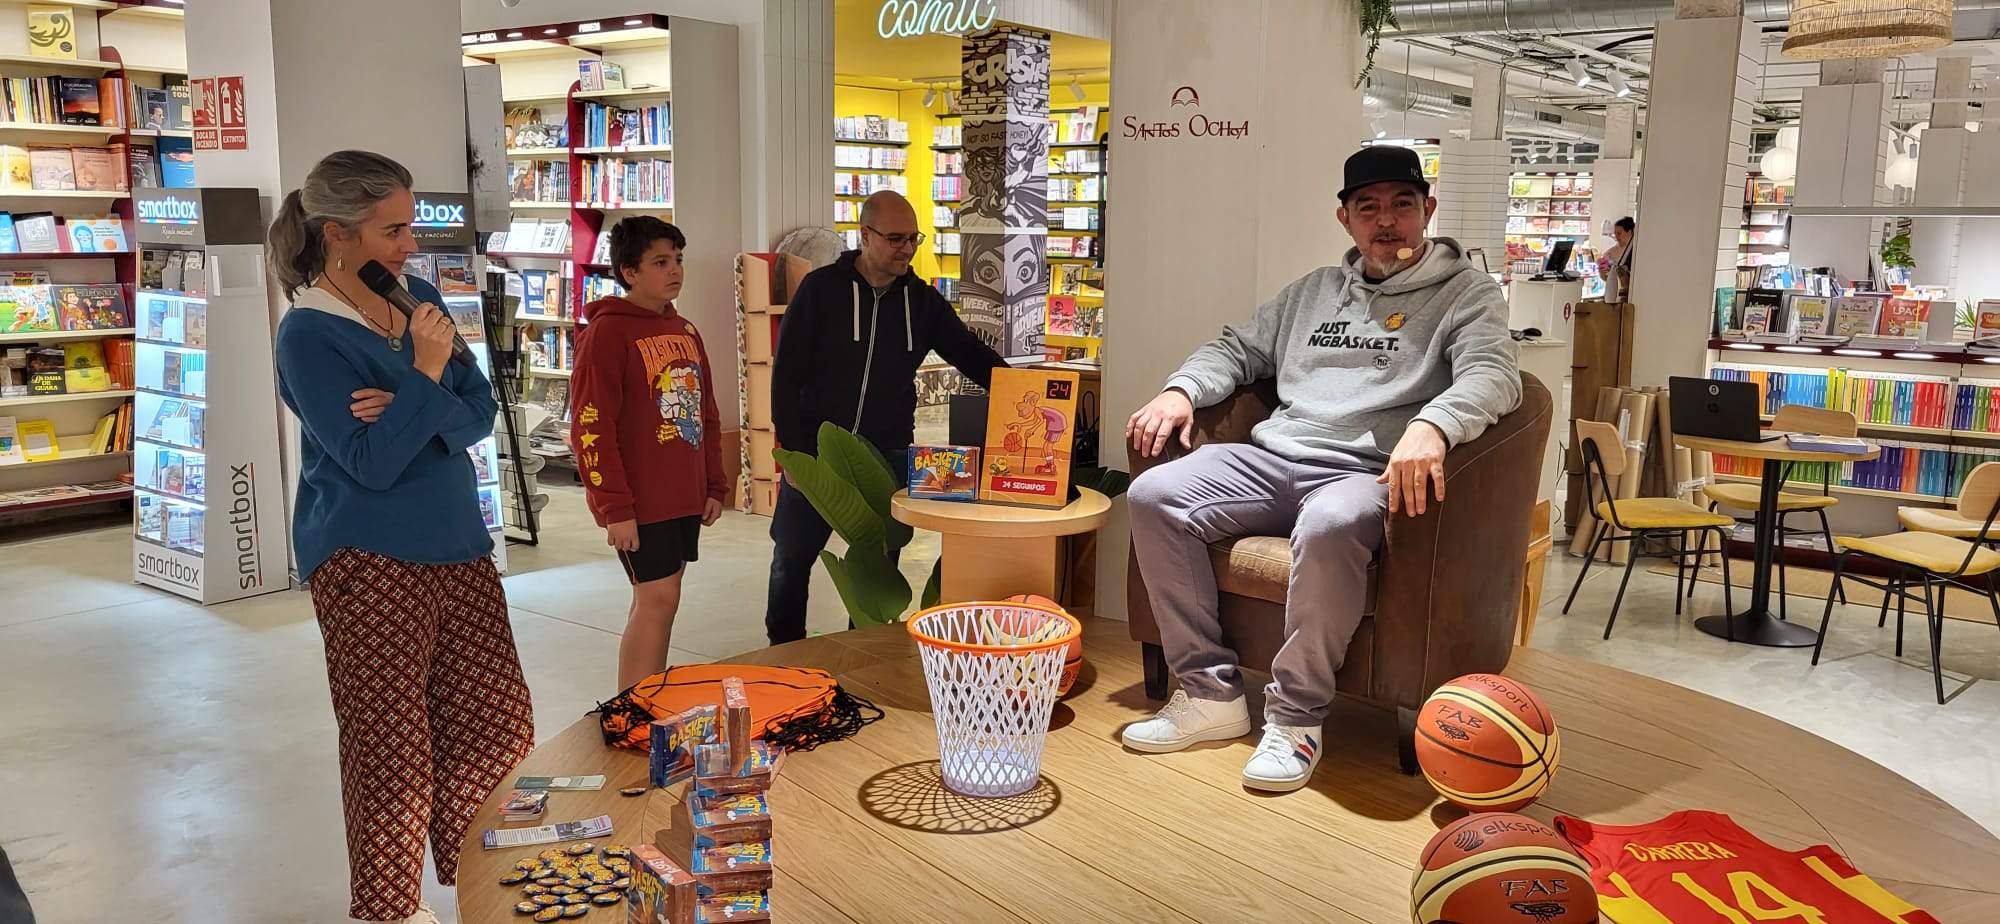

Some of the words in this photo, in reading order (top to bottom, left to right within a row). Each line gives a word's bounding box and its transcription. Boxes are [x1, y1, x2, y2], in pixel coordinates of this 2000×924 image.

[878, 0, 997, 39] comic
[195, 131, 208, 140] BOCA
[209, 130, 216, 139] DE
[195, 139, 218, 149] INCENDIO
[222, 135, 246, 144] EXTINTOR
[980, 133, 990, 143] SO
[138, 196, 199, 219] smartbox
[424, 229, 458, 239] emociones!
[1314, 321, 1350, 335] JUST
[1307, 334, 1400, 351] NGBASKET.
[1049, 382, 1071, 398] 24
[914, 451, 962, 471] BASKET
[1002, 481, 1011, 489] 24
[229, 463, 256, 590] smartbox
[138, 552, 200, 586] smartbox
[1467, 674, 1530, 713] elksport
[1438, 704, 1483, 729] FAB
[669, 716, 713, 753] BASKET
[1624, 841, 1739, 862] CARRERA
[1499, 879, 1570, 899] FAB
[1671, 871, 1827, 924] 14
